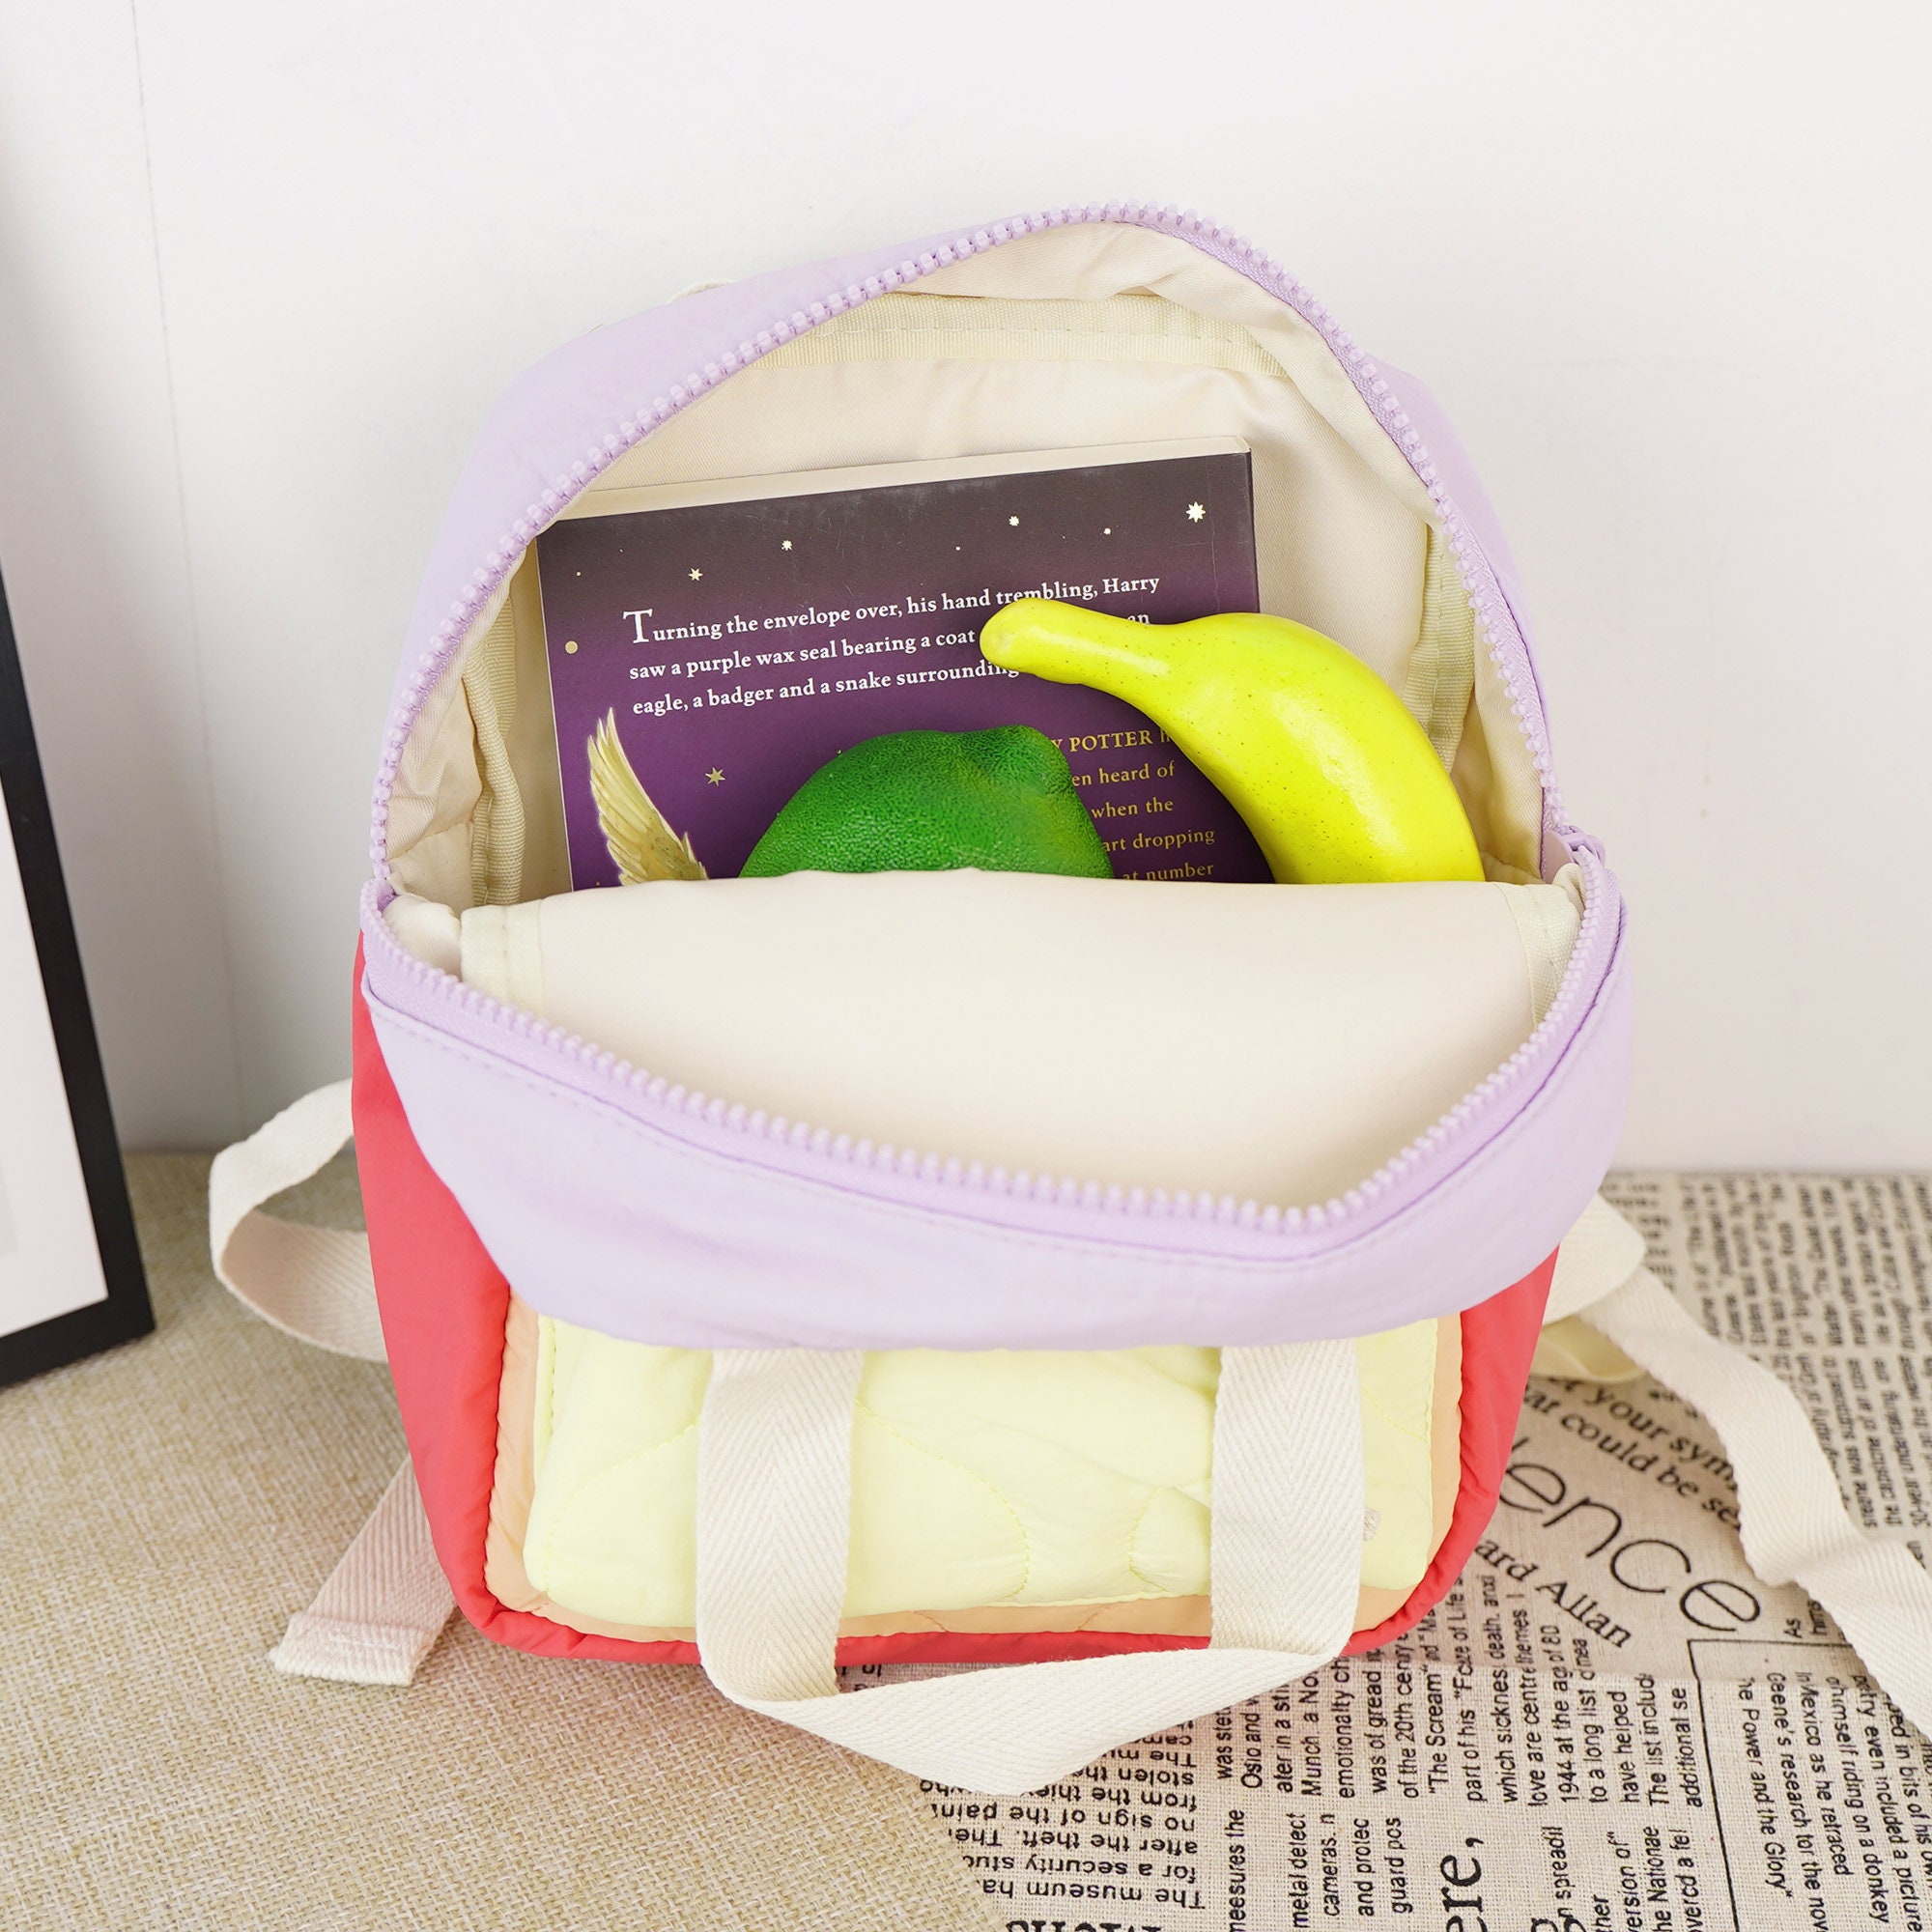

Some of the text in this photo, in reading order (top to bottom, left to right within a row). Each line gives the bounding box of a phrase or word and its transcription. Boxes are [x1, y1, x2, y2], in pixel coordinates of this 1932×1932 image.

[623, 609, 723, 643] Turning
[726, 615, 757, 634] the
[764, 608, 850, 630] envelope
[856, 604, 903, 619] over,
[906, 598, 937, 614] his
[942, 589, 989, 611] hand
[1102, 578, 1160, 595] Harry
[629, 629, 976, 680] saw a purple wax seal bearing a coat
[633, 694, 689, 717] eagle,
[693, 694, 703, 708] a
[707, 686, 774, 706] badger
[779, 677, 815, 698] and
[820, 683, 831, 695] a
[836, 671, 891, 693] snake
[1069, 729, 1153, 752] POTTER
[1099, 763, 1151, 782] heard
[1157, 760, 1175, 777] of
[1091, 797, 1174, 818] when the
[1132, 830, 1214, 850] dropping
[1146, 864, 1214, 881] number
[1585, 1387, 1670, 1439] your
[1561, 1413, 1658, 1471] could
[1658, 1466, 1698, 1496] be
[1498, 1436, 1761, 1633] ence
[1535, 1581, 1631, 1648] Allan
[1783, 1618, 1803, 1638] As
[1450, 1627, 1468, 1640] of
[1511, 1609, 1535, 1663] themes
[1304, 1713, 1318, 1722] a
[1491, 1663, 1513, 1744] sicknes
[1550, 1701, 1571, 1729] the
[1577, 1689, 1597, 1718] list
[1240, 1713, 1261, 1743] and
[1276, 1719, 1290, 1729] a
[1394, 1703, 1415, 1743] 20th
[1457, 1710, 1476, 1736] his
[1742, 1708, 1763, 1766] Power
[1271, 1736, 1292, 1749] in
[1364, 1734, 1383, 1749] of
[1458, 1741, 1478, 1759] of
[1525, 1732, 1543, 1762] are
[1555, 1737, 1575, 1753] at
[1577, 1724, 1604, 1762] long
[1641, 1741, 1664, 1766] list
[1670, 1688, 1702, 1807] additional se
[1864, 1726, 1888, 1770] even
[1894, 1745, 1914, 1759] in
[1150, 1750, 1197, 1768] The
[1215, 1747, 1234, 1778] was
[1397, 1748, 1417, 1776] the
[1810, 1753, 1826, 1773] as
[1119, 1768, 1194, 1787] stolen
[1371, 1756, 1387, 1793] was
[1463, 1766, 1487, 1802] part
[1495, 1749, 1519, 1804] which
[1557, 1760, 1580, 1803] 1944
[1589, 1769, 1605, 1779] a
[1618, 1761, 1640, 1804] have
[1751, 1772, 1773, 1803] and
[1898, 1767, 1919, 1797] bits
[1092, 1787, 1197, 1812] from the
[1398, 1780, 1418, 1798] of
[1526, 1771, 1548, 1806] love
[1588, 1782, 1608, 1804] to
[1646, 1773, 1669, 1805] The
[1814, 1780, 1833, 1801] he
[1009, 1805, 1195, 1832] no sign of the
[1224, 1809, 1245, 1837] the
[1757, 1808, 1777, 1834] the
[1781, 1752, 1811, 1828] research
[1803, 1861, 1823, 1889] the
[1876, 1776, 1909, 1843] included
[1910, 1804, 1932, 1818] of
[1091, 1833, 1129, 1852] the
[1140, 1839, 1197, 1857] after
[1822, 1807, 1854, 1875] retraced
[1841, 1761, 1863, 1808] riding
[1853, 1815, 1872, 1833] on
[1863, 1853, 1890, 1923] donkey
[1914, 1825, 1932, 1844] his
[1352, 1818, 1376, 1916] and protec
[1677, 1858, 1693, 1867] a
[1892, 1850, 1906, 1860] a
[1026, 1855, 1196, 1884] for a security
[1286, 1813, 1309, 1928] metal detect
[1027, 1881, 1142, 1902] museum
[1383, 1856, 1412, 1913] guard
[1154, 1889, 1205, 1909] The
[1892, 1867, 1922, 1932] picture
